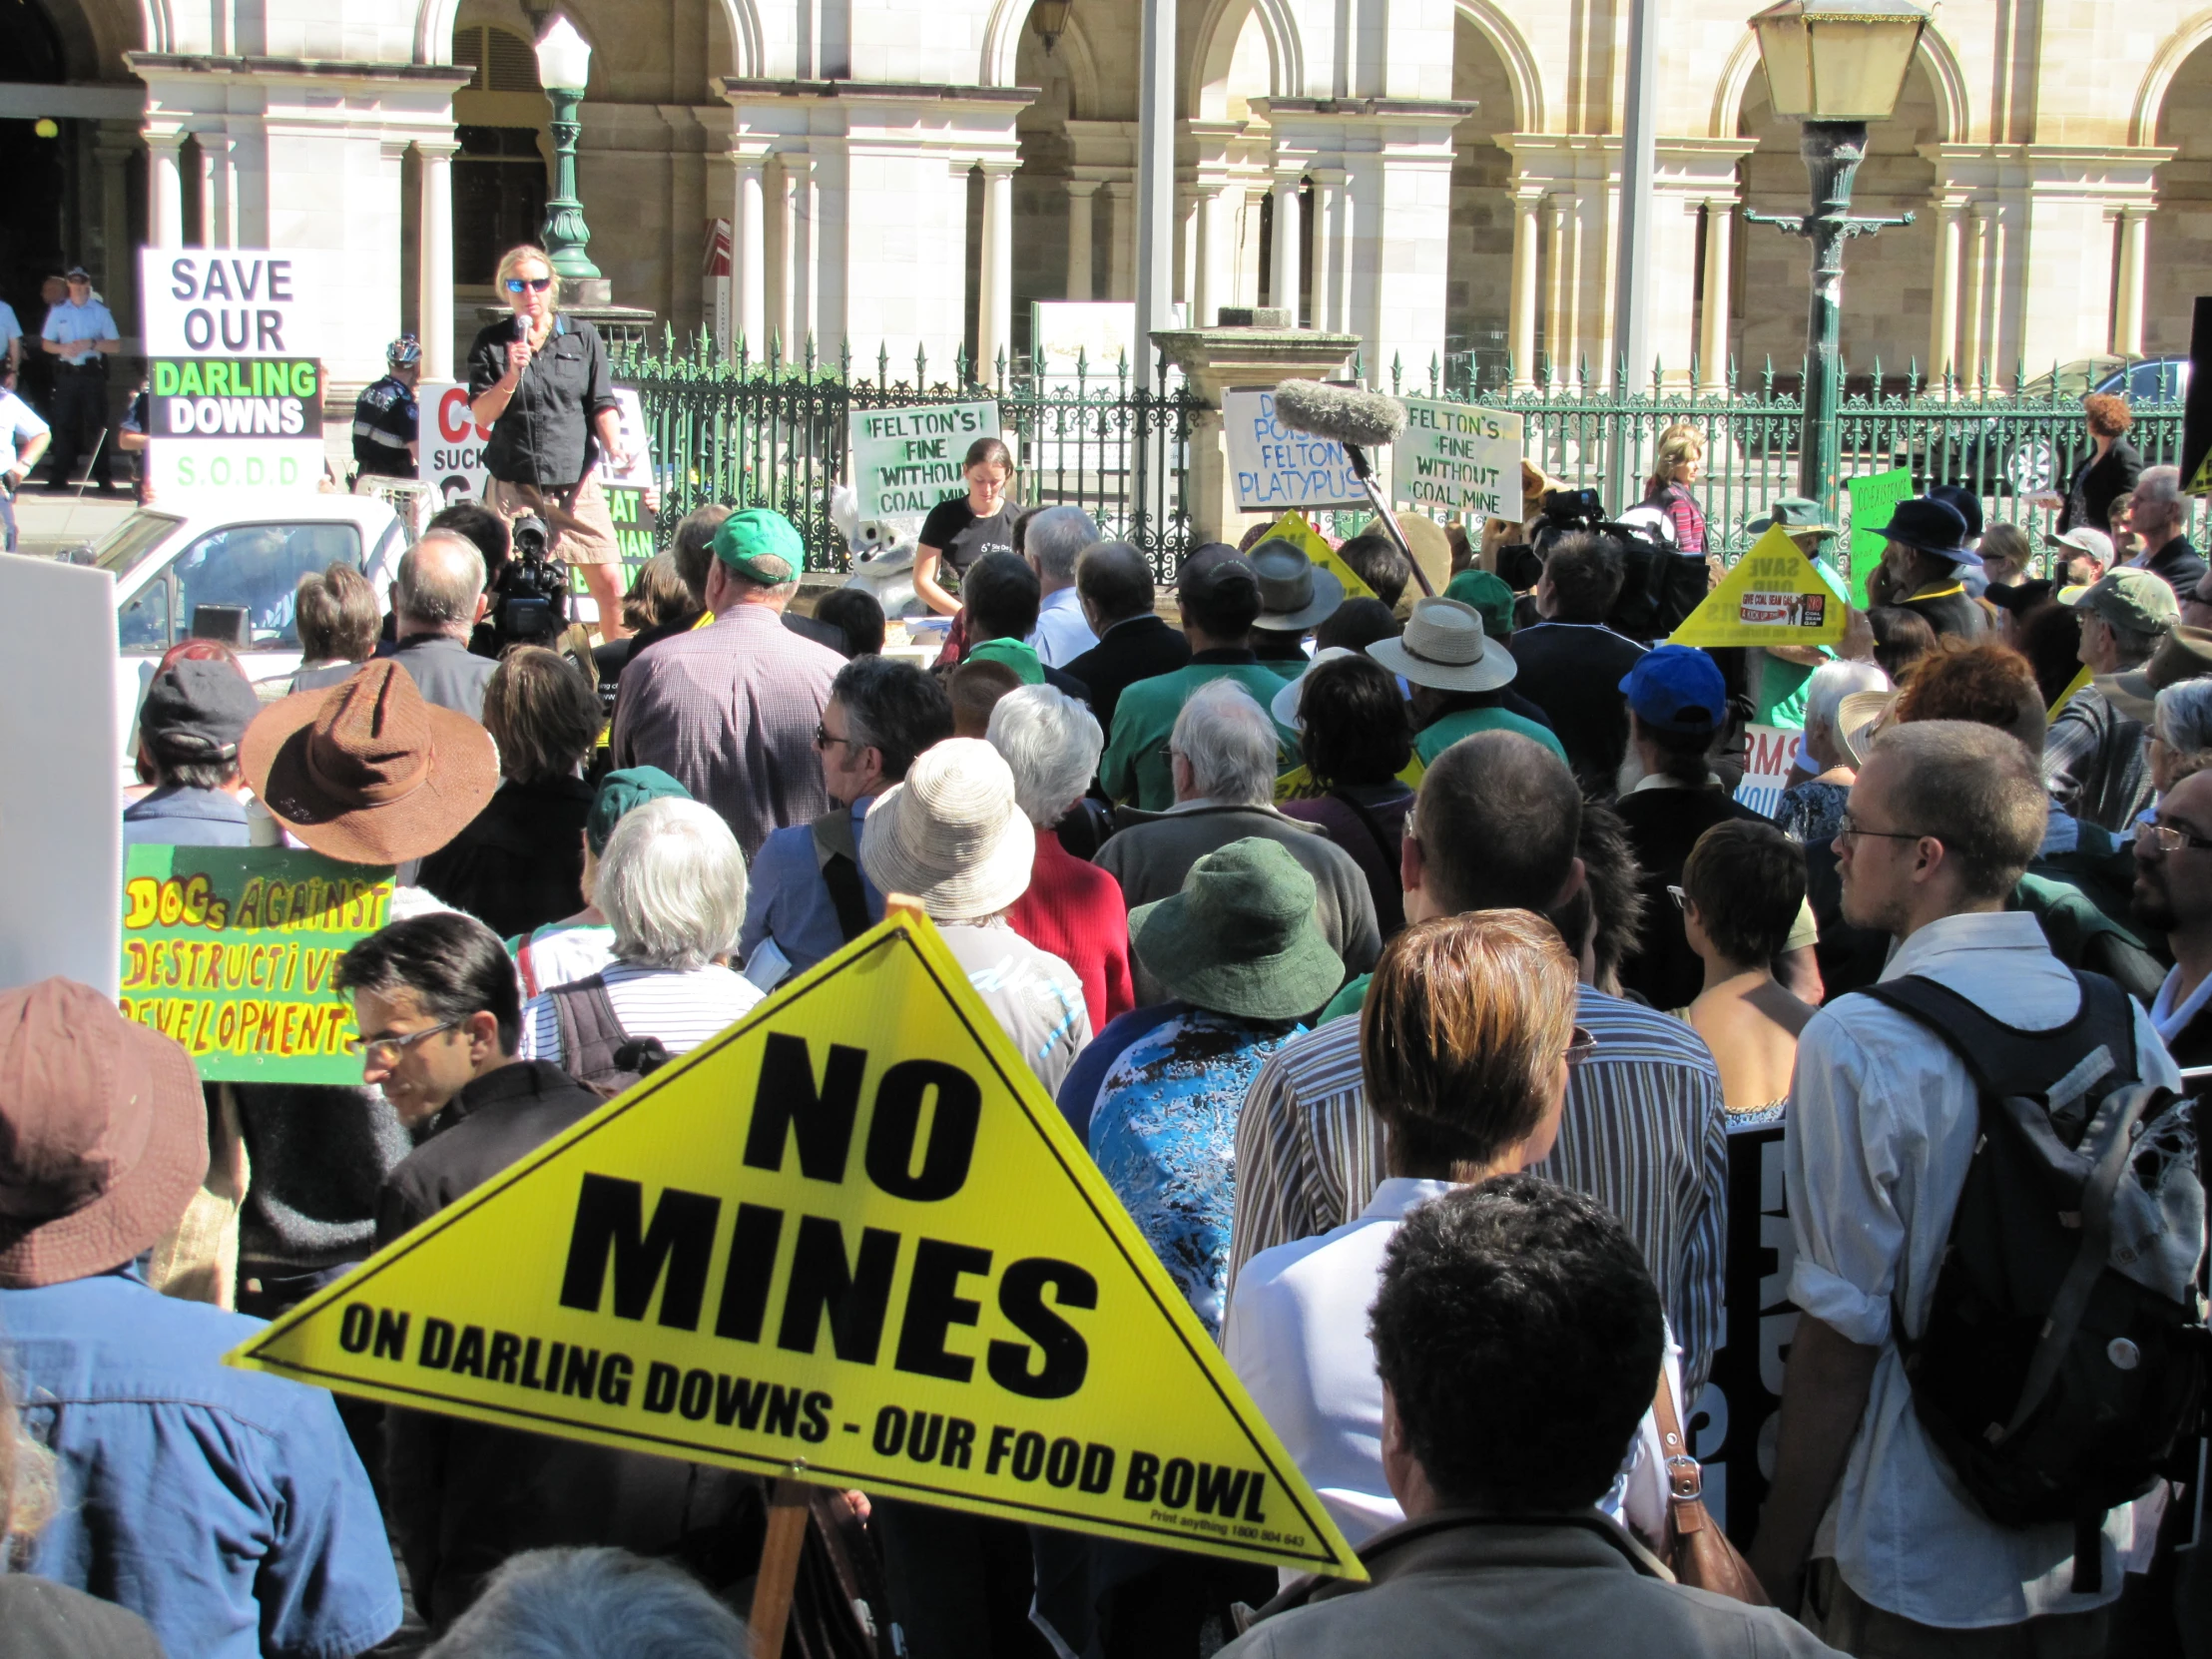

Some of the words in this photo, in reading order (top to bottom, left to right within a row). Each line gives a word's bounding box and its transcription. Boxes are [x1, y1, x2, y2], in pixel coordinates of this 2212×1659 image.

[172, 258, 293, 301] SAVE
[184, 307, 286, 351] OUR
[155, 361, 316, 397] DARLING
[170, 398, 304, 434] DOWNS
[871, 409, 977, 438] FELTON'S
[1409, 407, 1499, 439] FELTON'S
[905, 439, 947, 460] FINE
[1262, 441, 1344, 468] FELTON
[1438, 435, 1474, 459] FINE
[880, 462, 965, 486] WITHOU
[1239, 467, 1367, 501] PLATYPUS
[1416, 455, 1499, 487] WITHOUT
[880, 491, 931, 513] COAL
[1412, 480, 1456, 505] COAL
[1463, 489, 1500, 514] MINE
[1755, 593, 1767, 605] COAL
[1769, 594, 1782, 606] SEAM
[1807, 595, 1823, 612] NO
[743, 1030, 982, 1203] NO
[559, 1171, 1099, 1399] MINES
[339, 1302, 410, 1363] ON
[417, 1317, 635, 1406] DARLING
[642, 1360, 834, 1443] DOWNS
[871, 1404, 977, 1470] OUR
[984, 1424, 1116, 1494] FOOD
[1123, 1449, 1268, 1524] BOWL
[1150, 1508, 1178, 1523] Print
[1180, 1515, 1228, 1536] anything
[1232, 1525, 1259, 1540] 1800
[1284, 1534, 1305, 1547] 643
